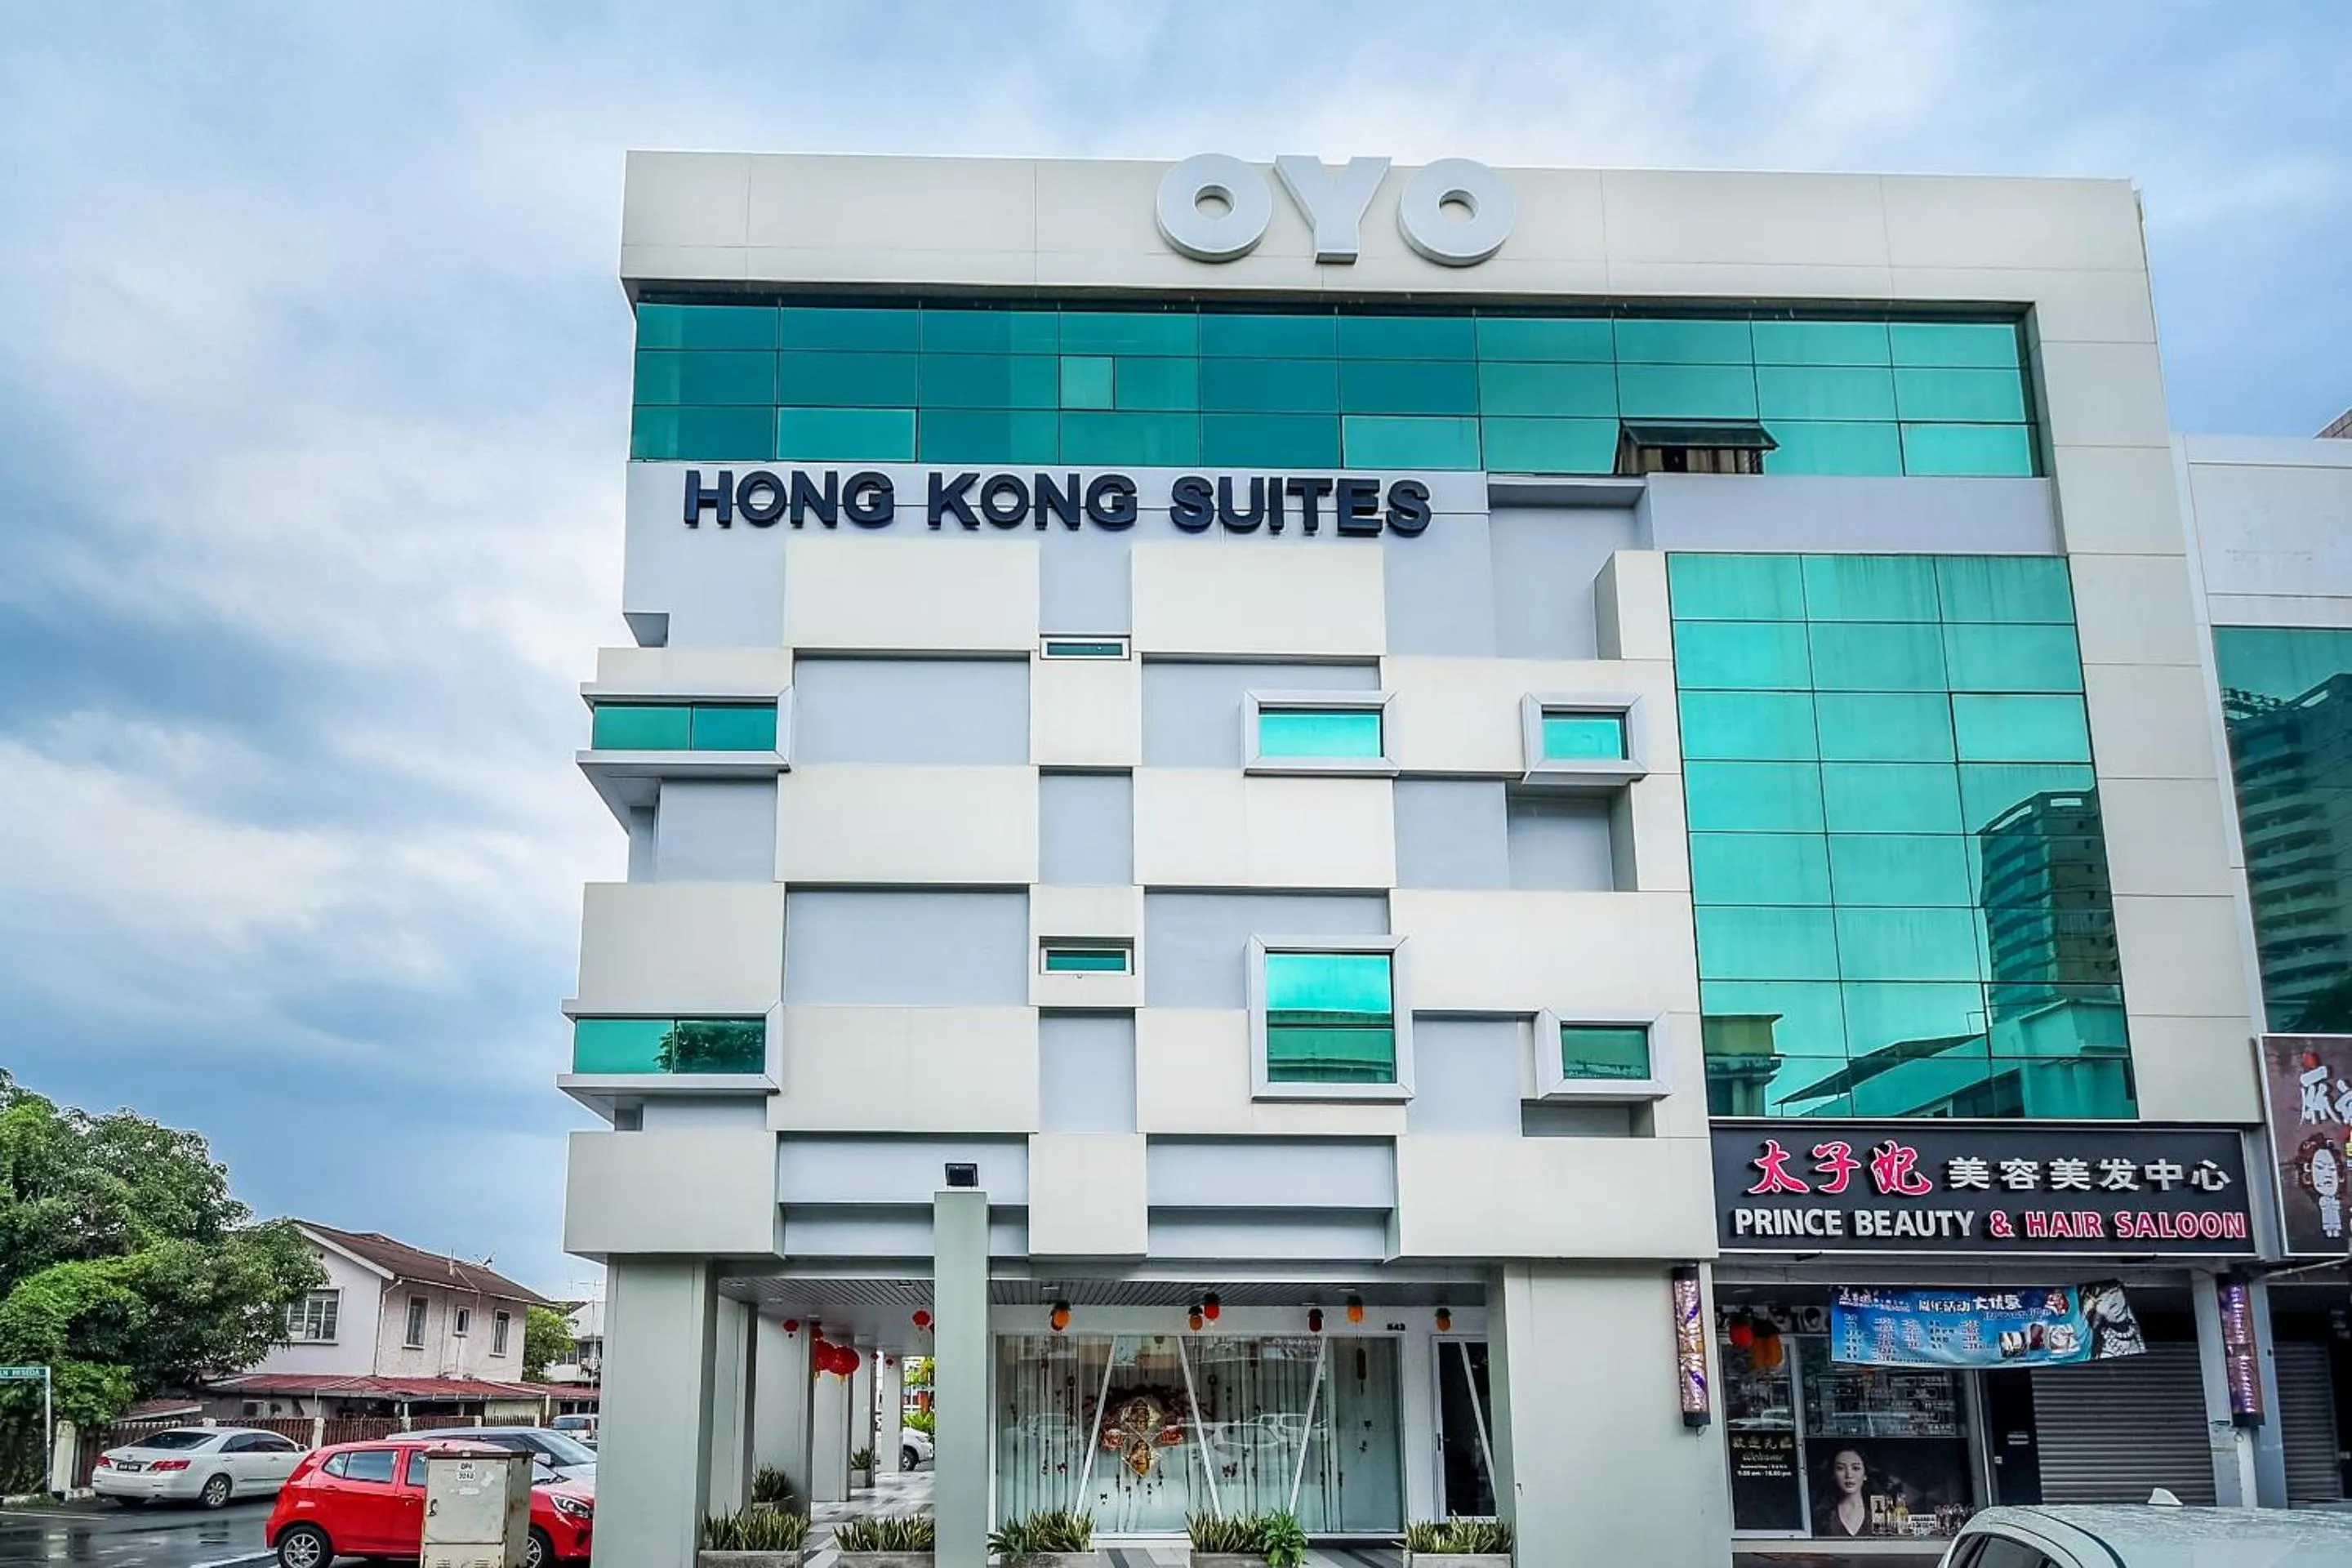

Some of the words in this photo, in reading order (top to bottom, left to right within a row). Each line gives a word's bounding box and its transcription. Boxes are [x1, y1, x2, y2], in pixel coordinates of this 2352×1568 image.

[1156, 153, 1517, 267] OYO
[684, 470, 894, 528] HONG
[928, 472, 1138, 532] KONG
[1169, 475, 1432, 537] SUITES
[1748, 1139, 1933, 1196] 太子妃
[1948, 1156, 2232, 1192] 美容美发中心
[1735, 1209, 1843, 1236] PRINCE
[1854, 1209, 1975, 1237] BEAUTY
[1989, 1210, 2015, 1238] &
[2025, 1211, 2105, 1238] HAIR
[2114, 1212, 2247, 1240] SALOON
